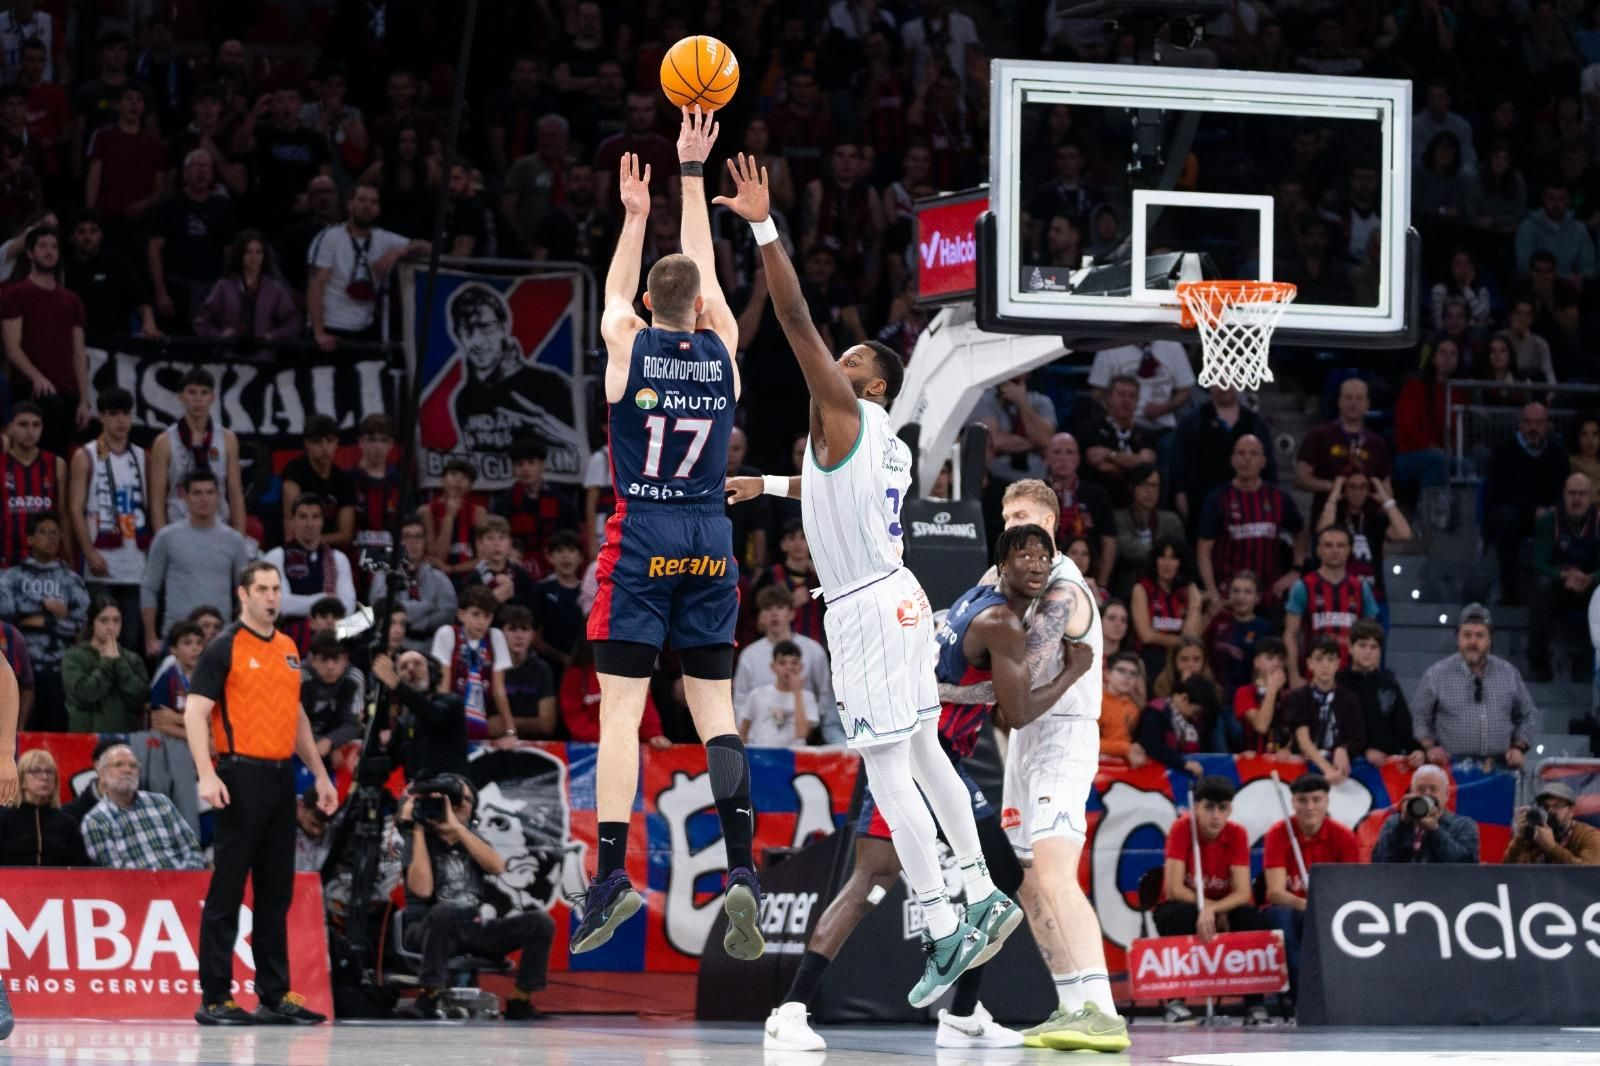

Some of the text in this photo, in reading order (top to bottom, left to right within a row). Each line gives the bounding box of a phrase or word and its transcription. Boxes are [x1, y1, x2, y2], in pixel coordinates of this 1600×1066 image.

[643, 355, 723, 382] ROGKAVOPOULOS
[663, 395, 727, 410] AMUTIO
[642, 414, 713, 479] 17
[8, 495, 52, 509] CAZOO
[911, 521, 977, 539] SPALDING
[648, 555, 727, 578] Recalvi
[1136, 944, 1281, 980] AlkiVent
[89, 978, 257, 994] CERVECEOS
